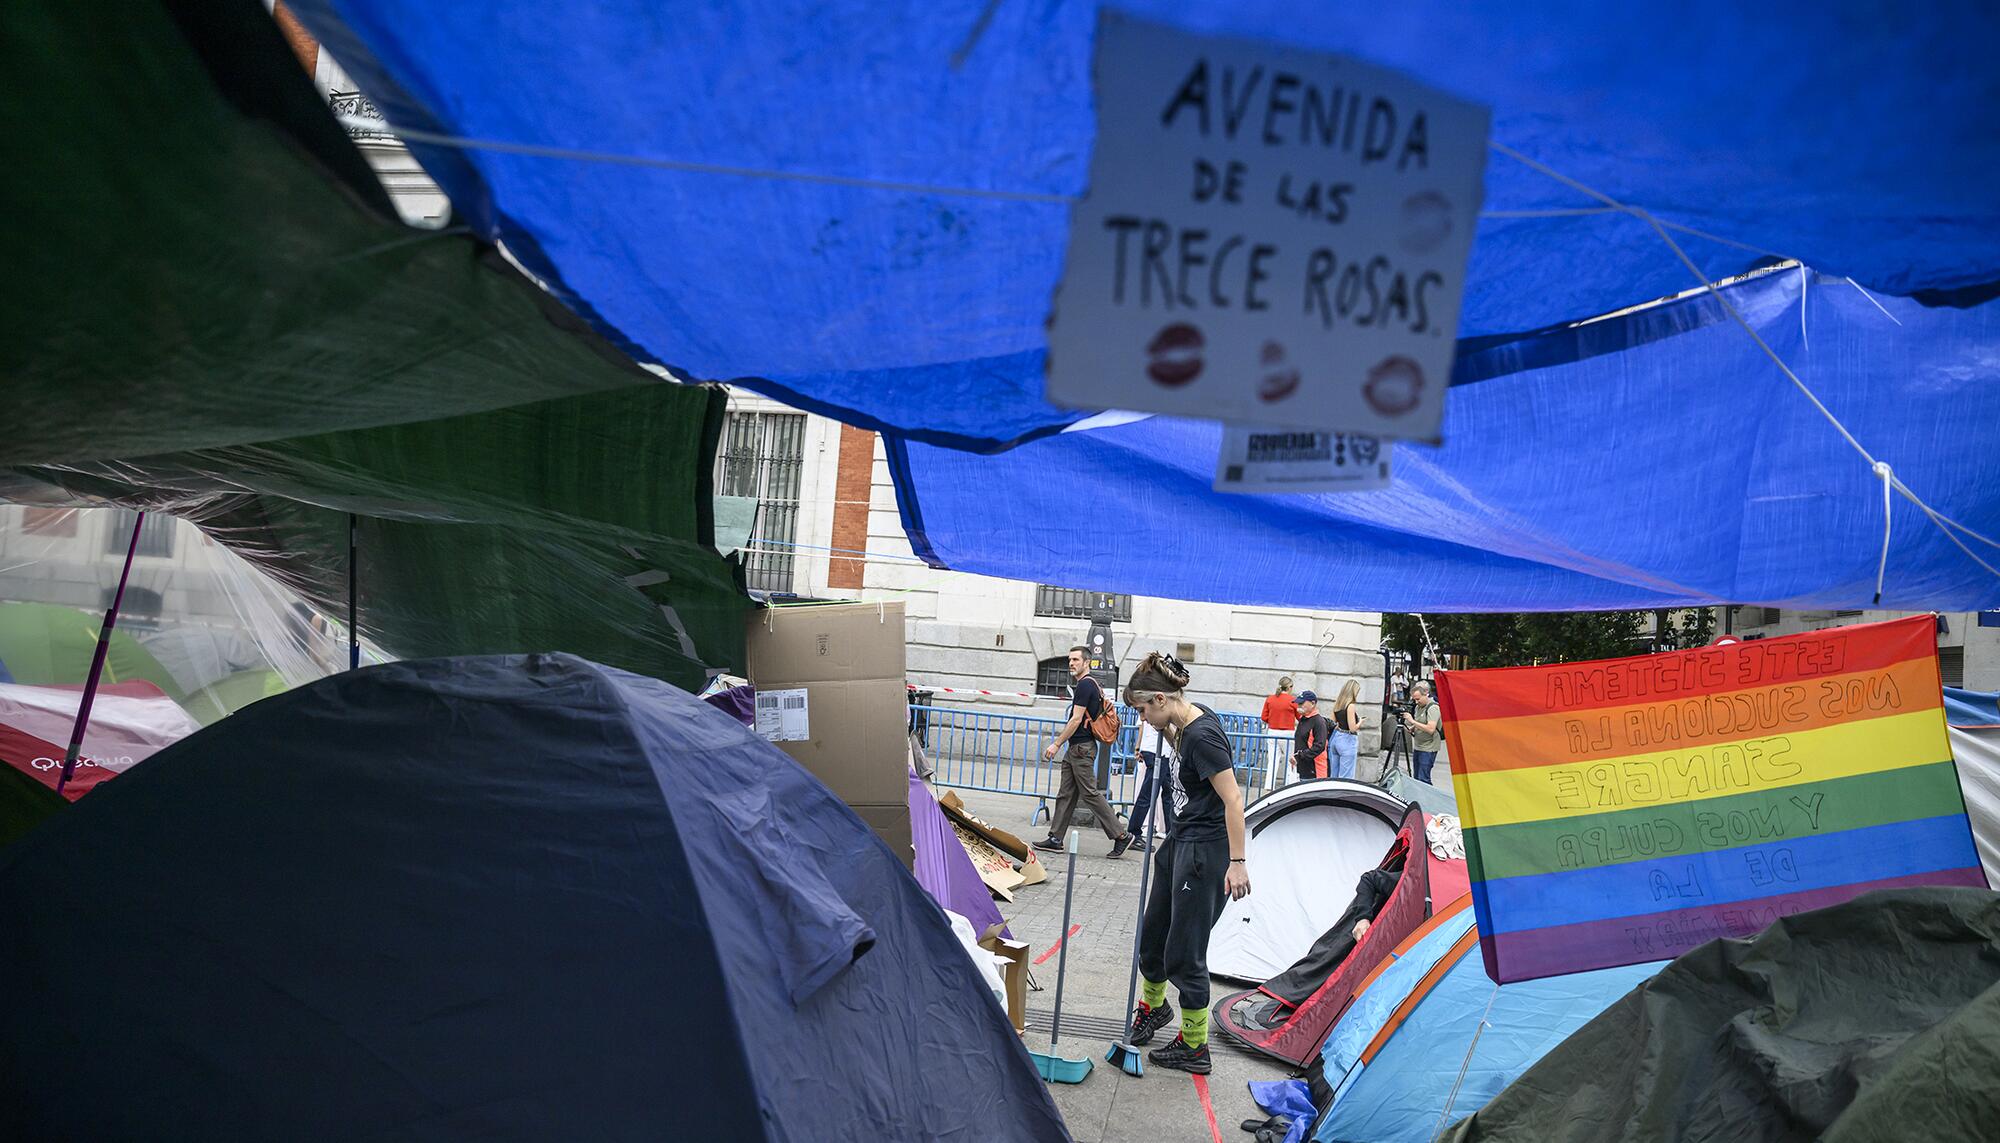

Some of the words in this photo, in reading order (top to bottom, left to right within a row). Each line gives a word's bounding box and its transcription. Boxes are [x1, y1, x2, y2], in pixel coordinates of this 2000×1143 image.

[1161, 58, 1430, 171] AVENIDA
[1192, 158, 1247, 204] DE
[1277, 174, 1355, 225] LAS
[1103, 214, 1278, 312] TRECE
